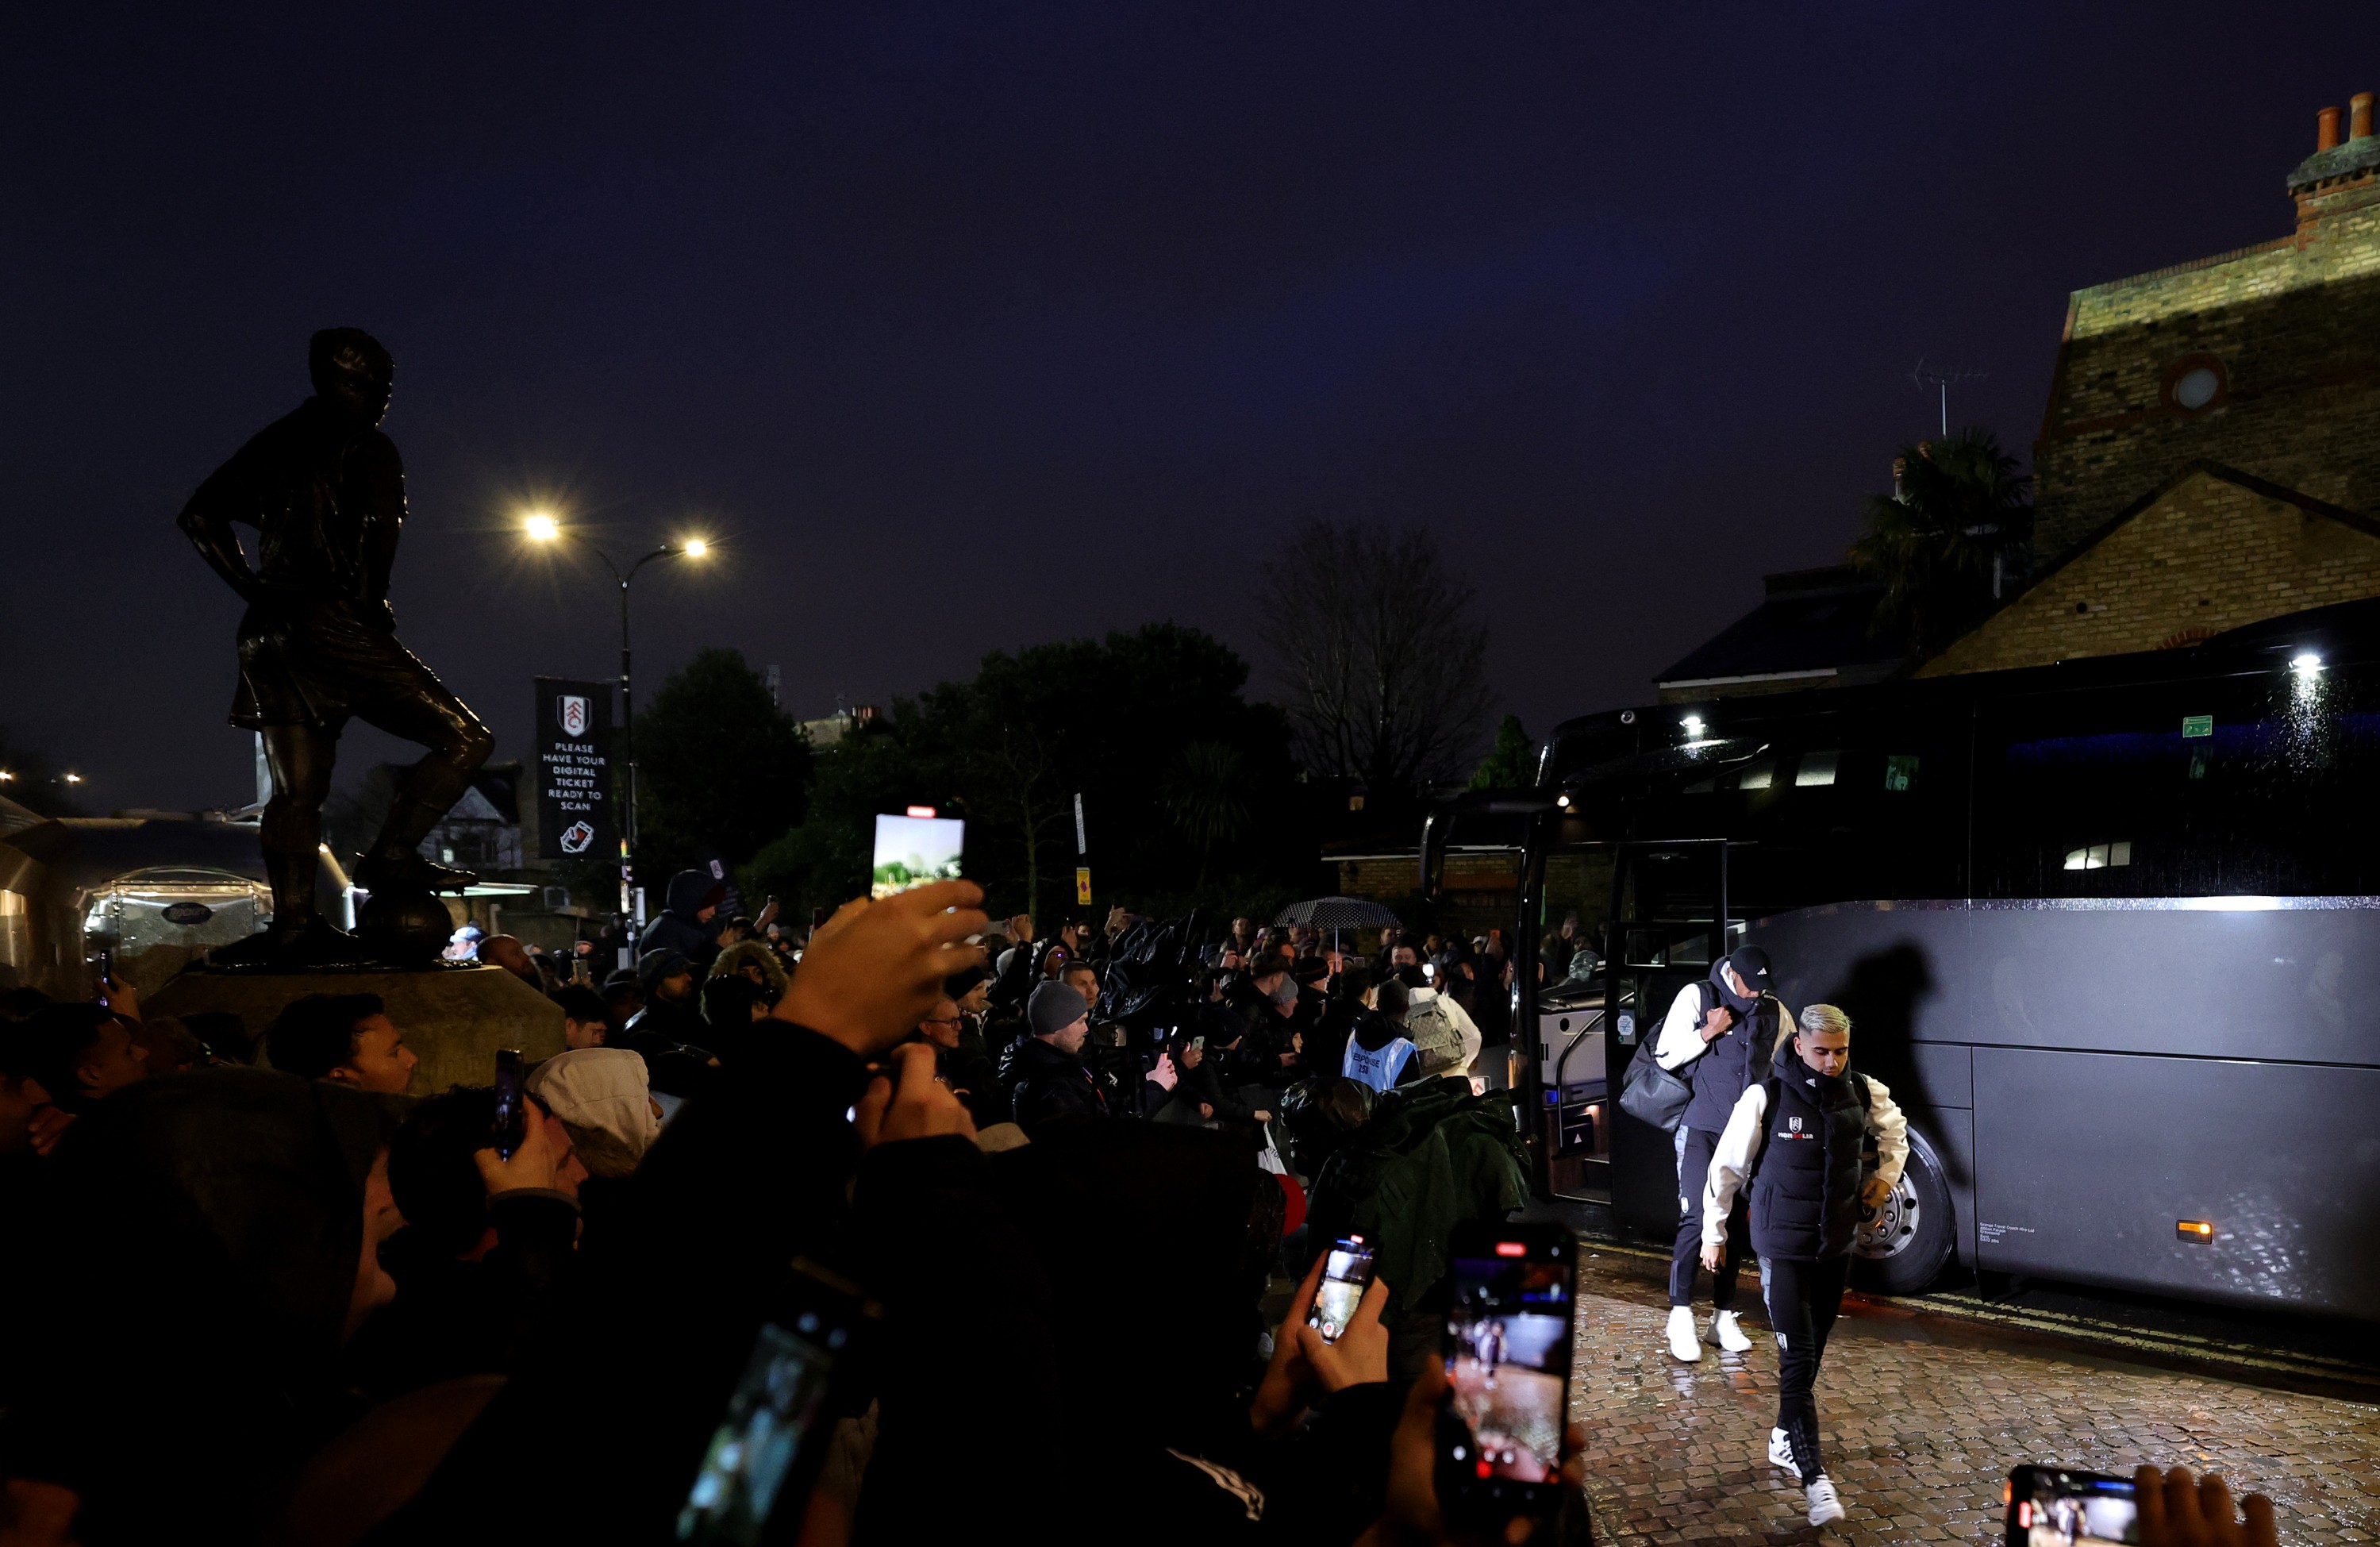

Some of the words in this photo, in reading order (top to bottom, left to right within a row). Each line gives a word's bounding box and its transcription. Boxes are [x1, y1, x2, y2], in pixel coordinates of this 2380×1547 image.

[555, 742, 594, 753] PLEASE
[543, 753, 572, 764] HAVE
[576, 755, 606, 766] YOUR
[553, 766, 596, 777] DIGITAL
[556, 778, 594, 788] TICKET
[548, 789, 583, 799] READY
[587, 791, 602, 800] TO
[560, 802, 590, 811] SCAN
